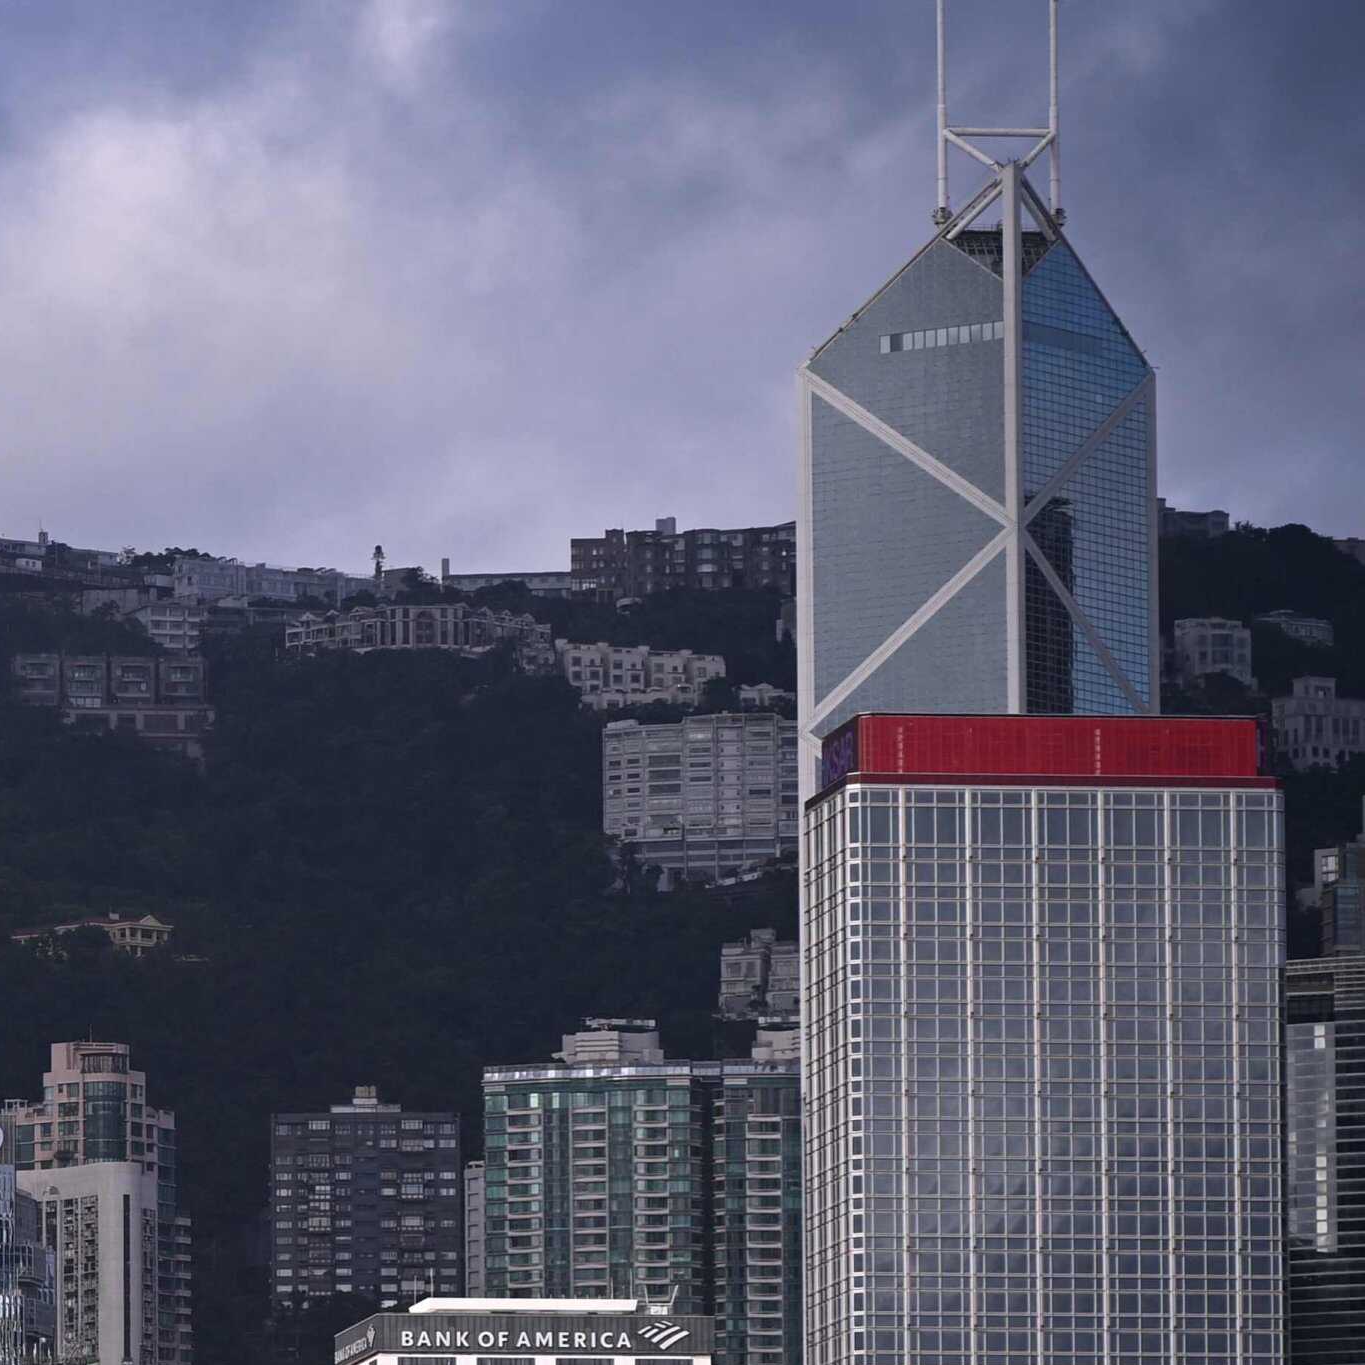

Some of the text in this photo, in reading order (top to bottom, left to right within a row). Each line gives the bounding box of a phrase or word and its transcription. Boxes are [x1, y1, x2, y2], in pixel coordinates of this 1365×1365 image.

[400, 1331, 632, 1348] BANK OF AMERICA
